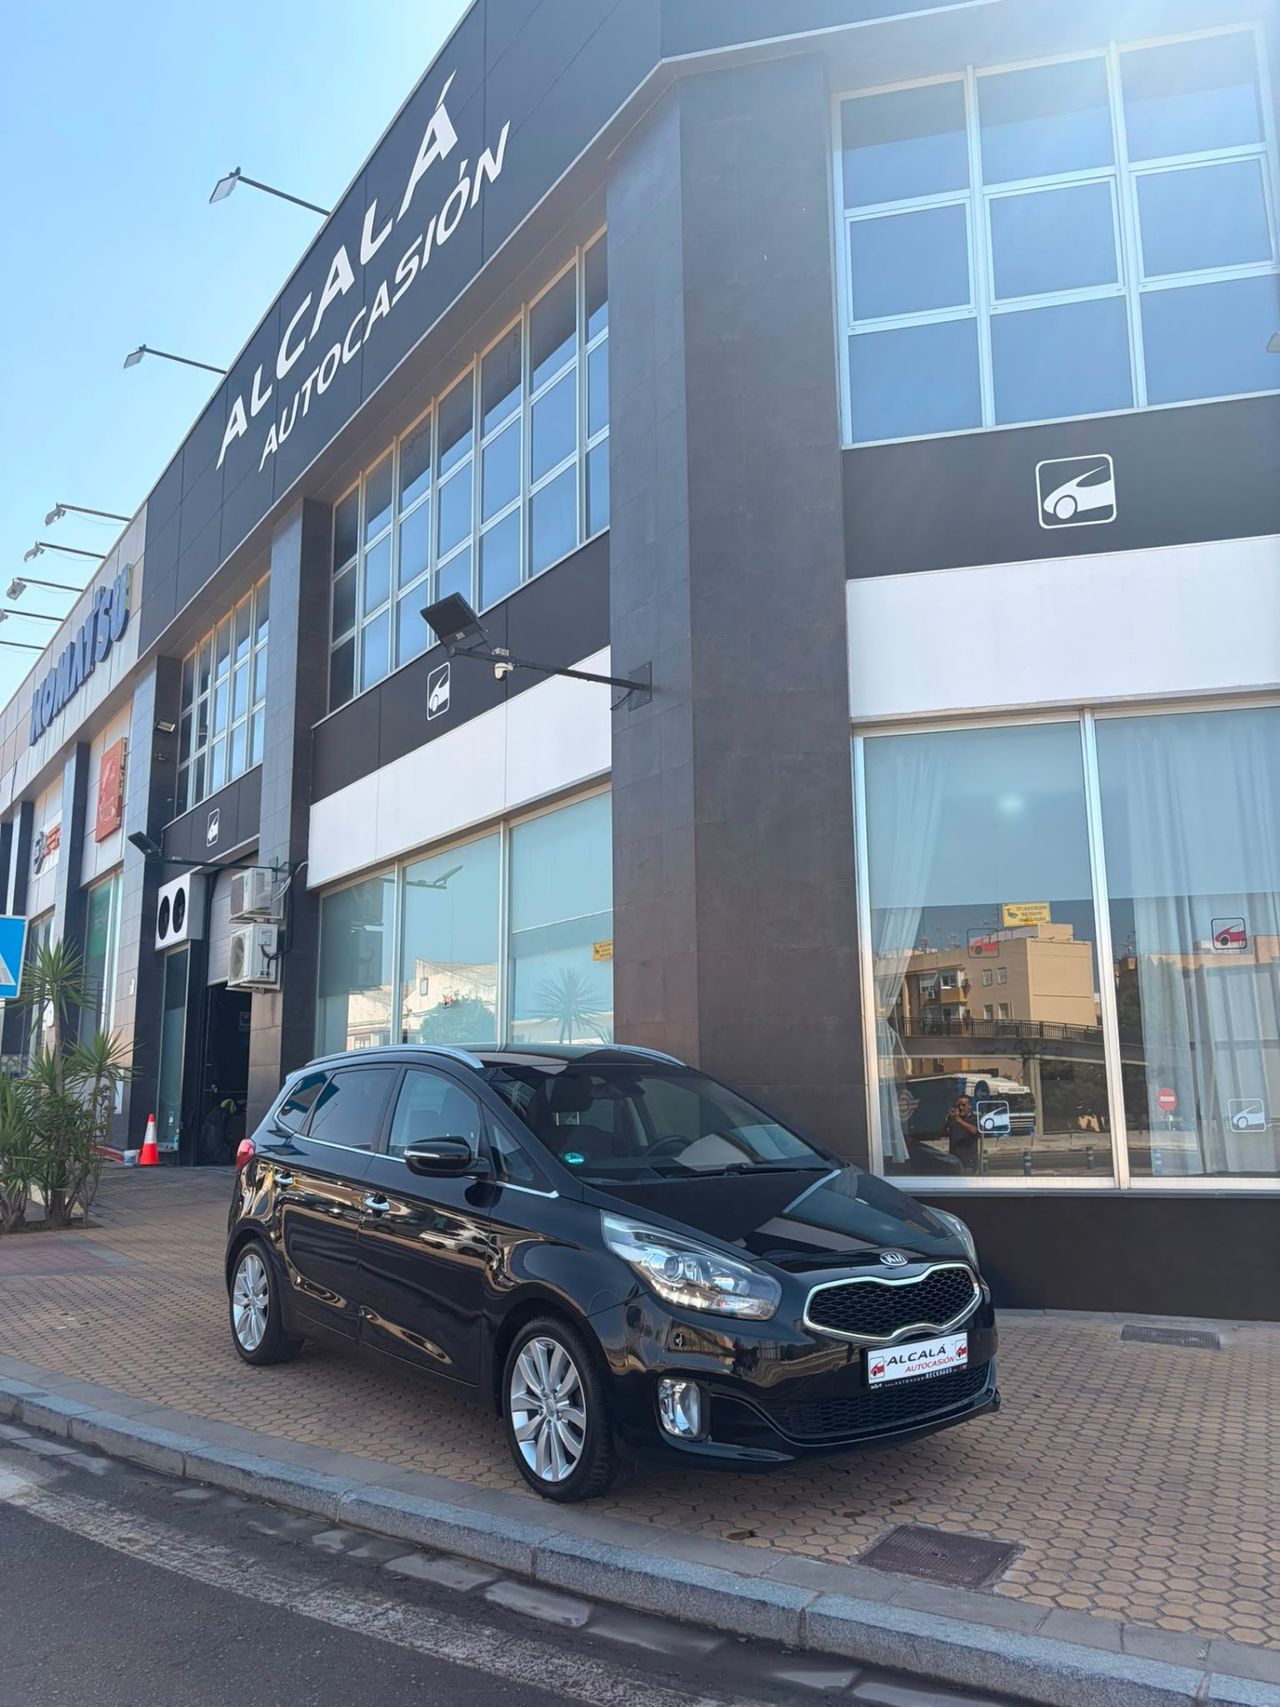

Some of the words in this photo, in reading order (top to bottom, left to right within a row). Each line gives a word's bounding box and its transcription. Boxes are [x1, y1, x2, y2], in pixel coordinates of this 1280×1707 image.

[216, 68, 459, 471] ALCALÁ
[258, 120, 511, 472] AUTOCASIÓN
[29, 563, 133, 746] KOMATSU
[886, 1343, 947, 1367] ALCALÁ
[904, 1355, 955, 1374] AUTOCASIÓN
